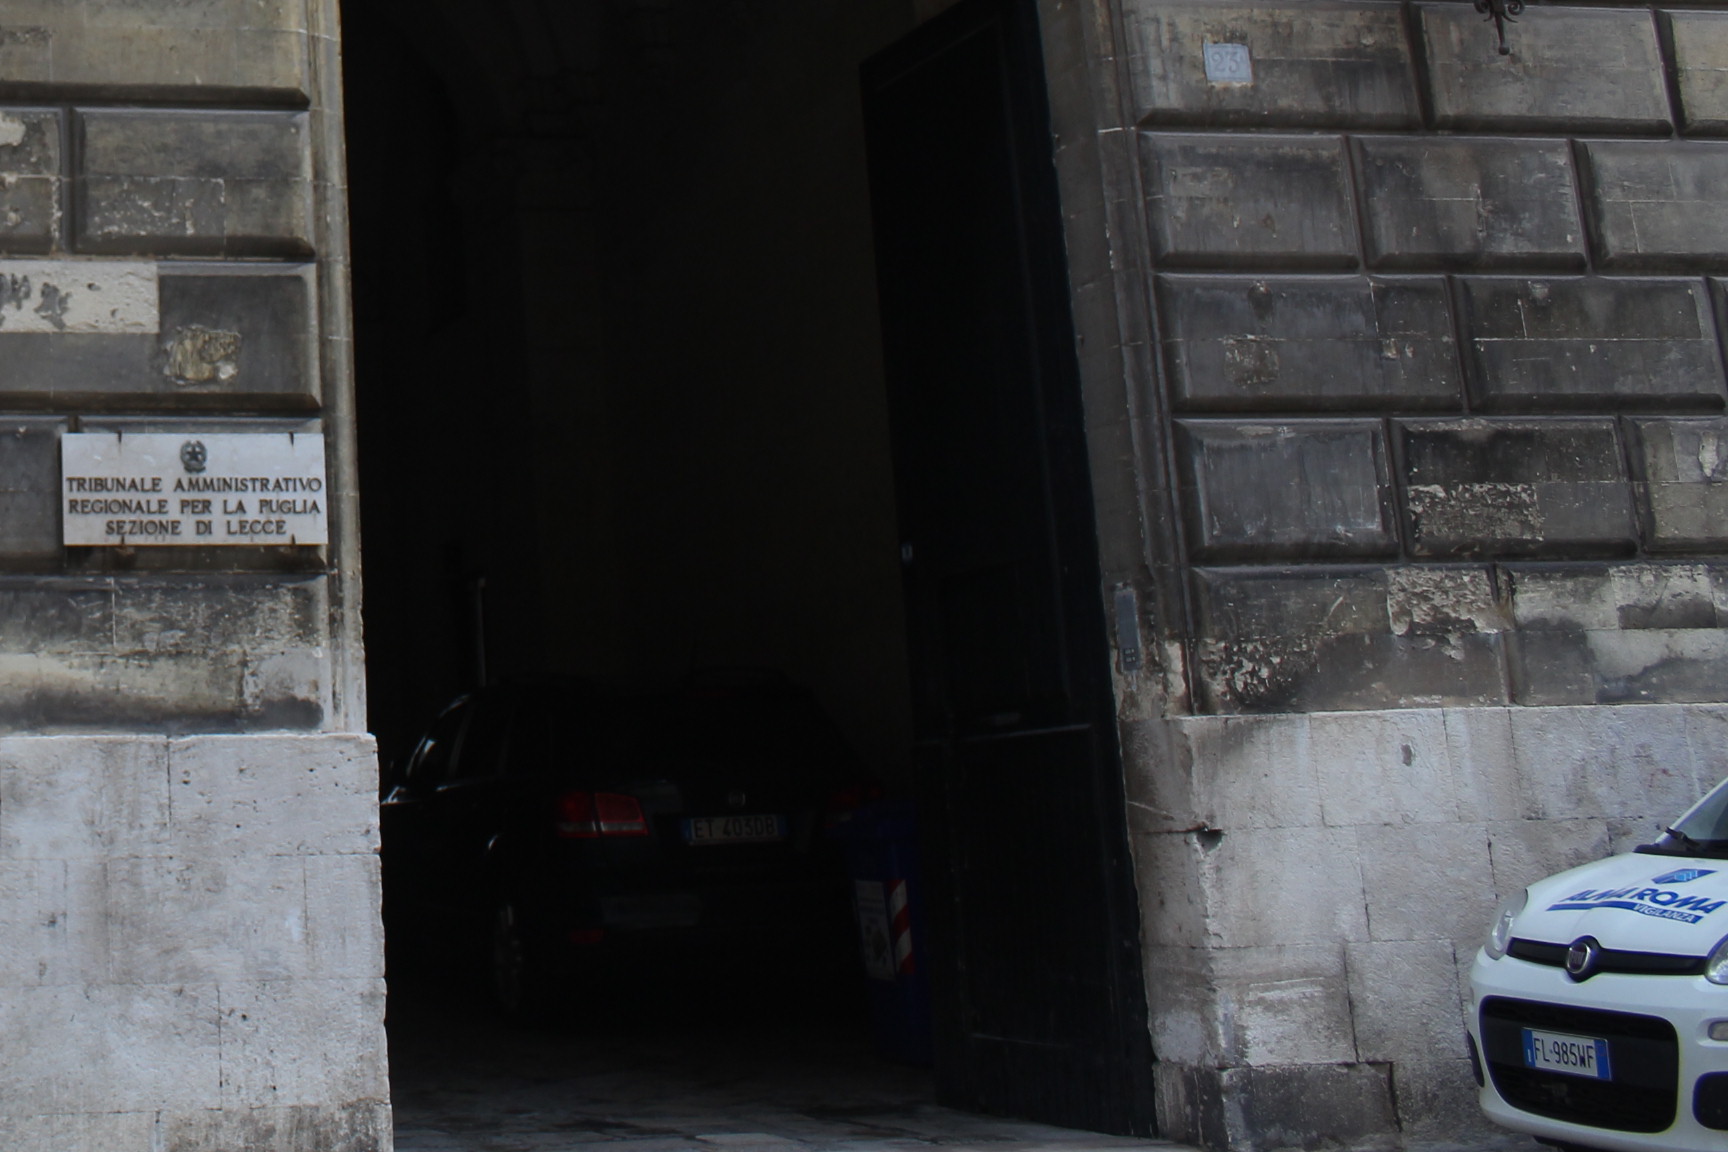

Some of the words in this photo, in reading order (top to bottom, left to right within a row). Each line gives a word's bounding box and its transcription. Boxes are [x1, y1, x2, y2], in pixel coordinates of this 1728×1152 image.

[66, 477, 162, 493] TRIBUNALE
[173, 477, 322, 493] AMMINISTRATIVO
[68, 499, 169, 515] REGIONALE
[180, 499, 212, 514] PER
[223, 499, 246, 515] LA
[259, 499, 320, 514] PUGLIA
[105, 519, 181, 536] SEZIONE
[195, 520, 212, 535] DI
[227, 520, 286, 535] LECCE
[1627, 887, 1728, 914] ROMA
[1631, 903, 1696, 923] VIGILANZA
